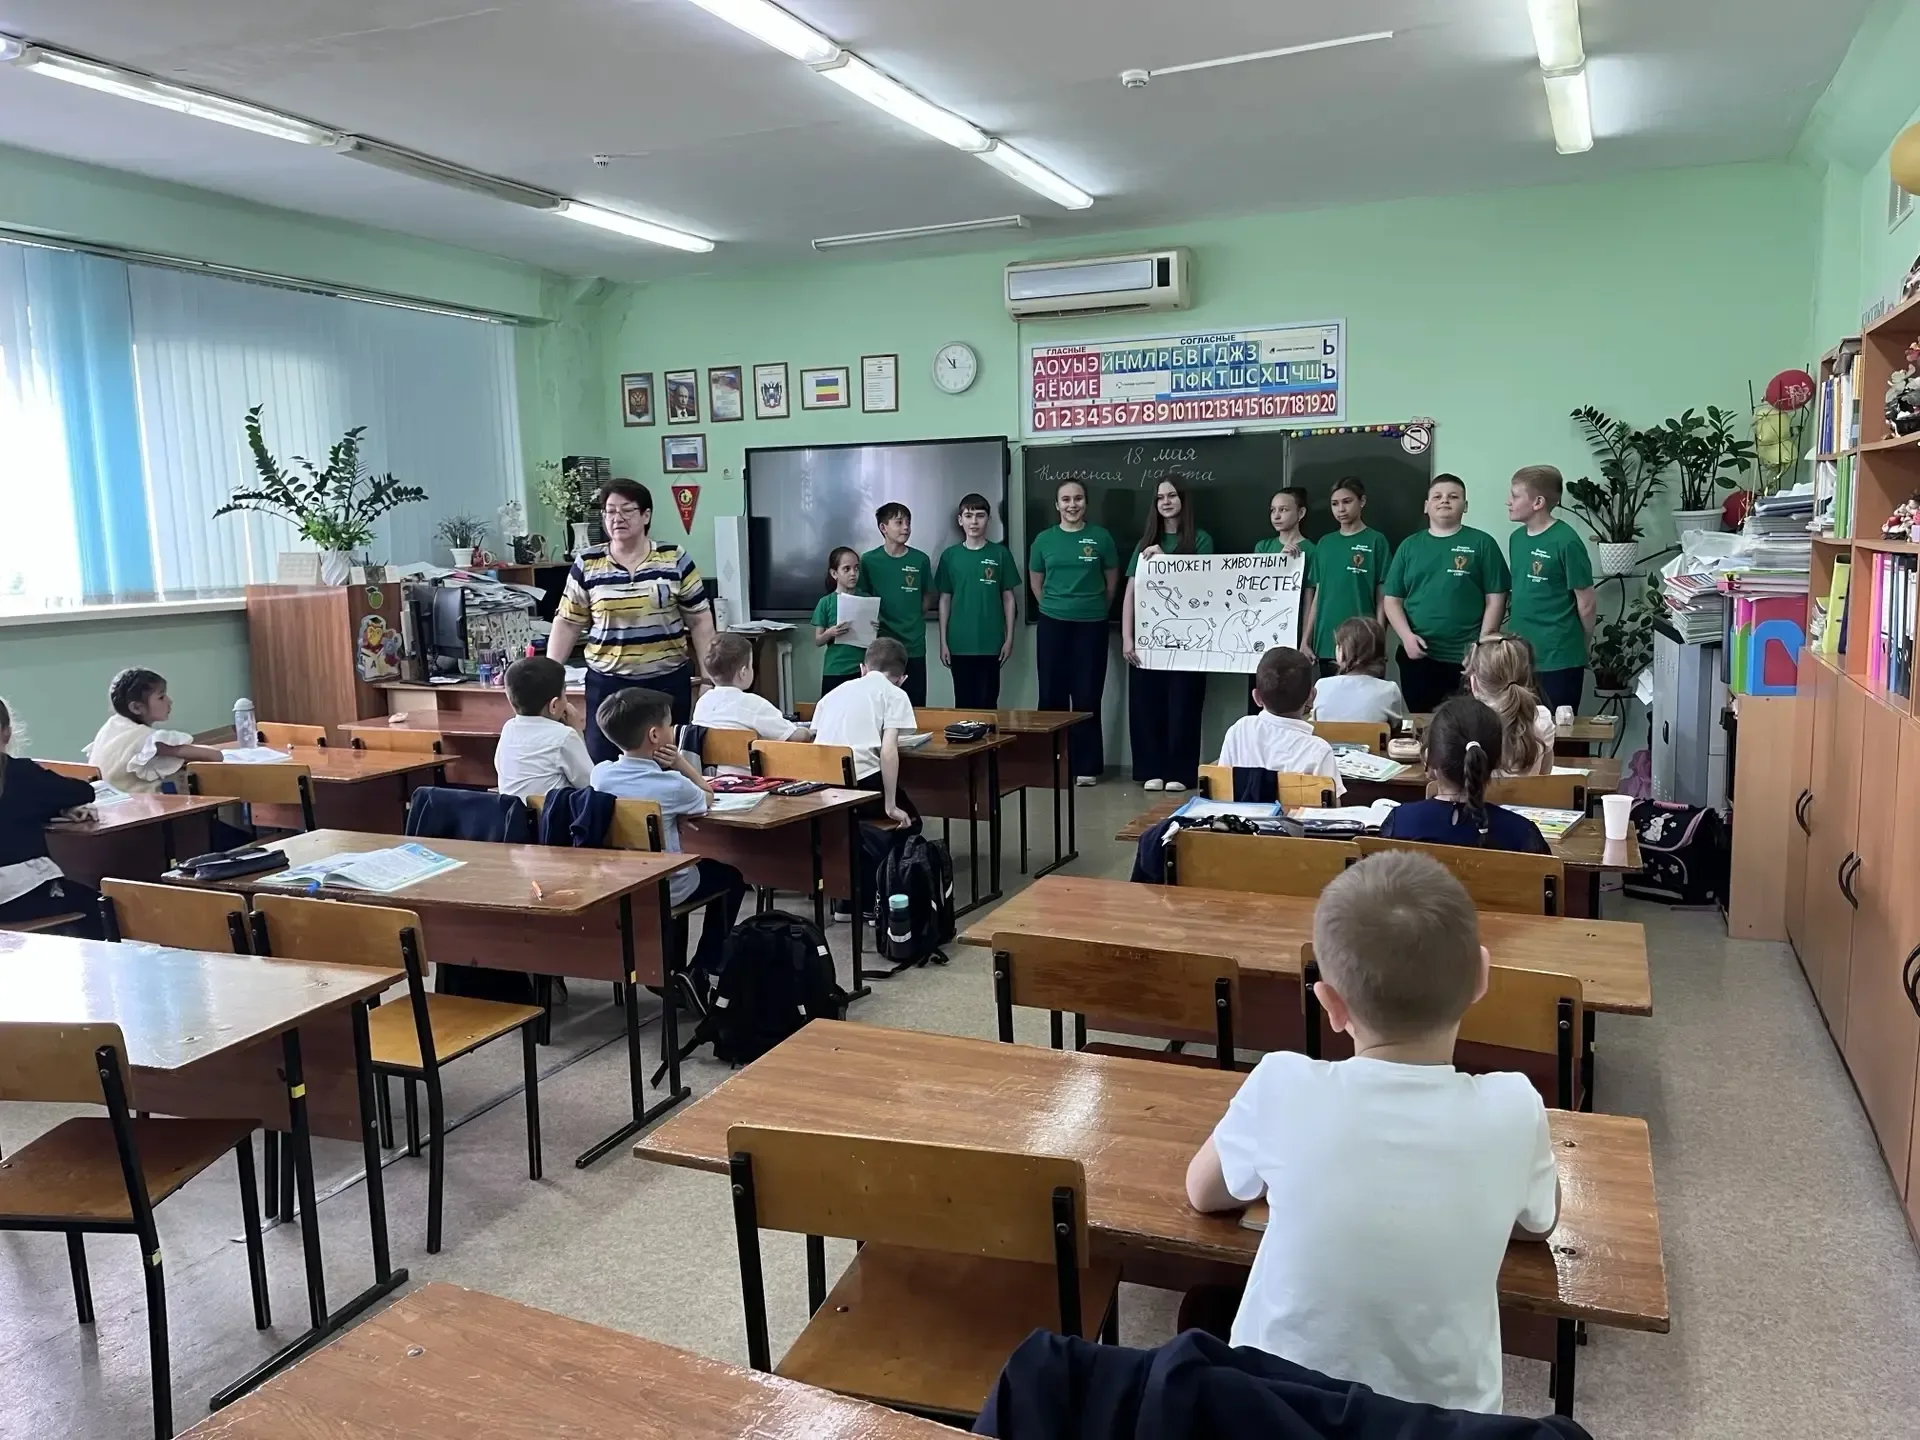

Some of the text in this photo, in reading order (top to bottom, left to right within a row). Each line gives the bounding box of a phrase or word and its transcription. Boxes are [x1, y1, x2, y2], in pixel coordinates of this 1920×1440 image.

[1180, 334, 1236, 346] СОГЛАСНЫЕ
[1047, 346, 1087, 356] ГЛАСНЫЕ
[1035, 394, 1335, 428] 0 1 2 3 4 5 6 7 8 9 10 11 12 13 14 15 16 17 18 19 20
[1123, 447, 1199, 465] 18 мая
[1033, 464, 1125, 481] Классная
[1147, 555, 1288, 575] ПОМОЖЕМ ЖИВОТНЫМ
[1236, 571, 1301, 592] ВМЕСТЕ!
